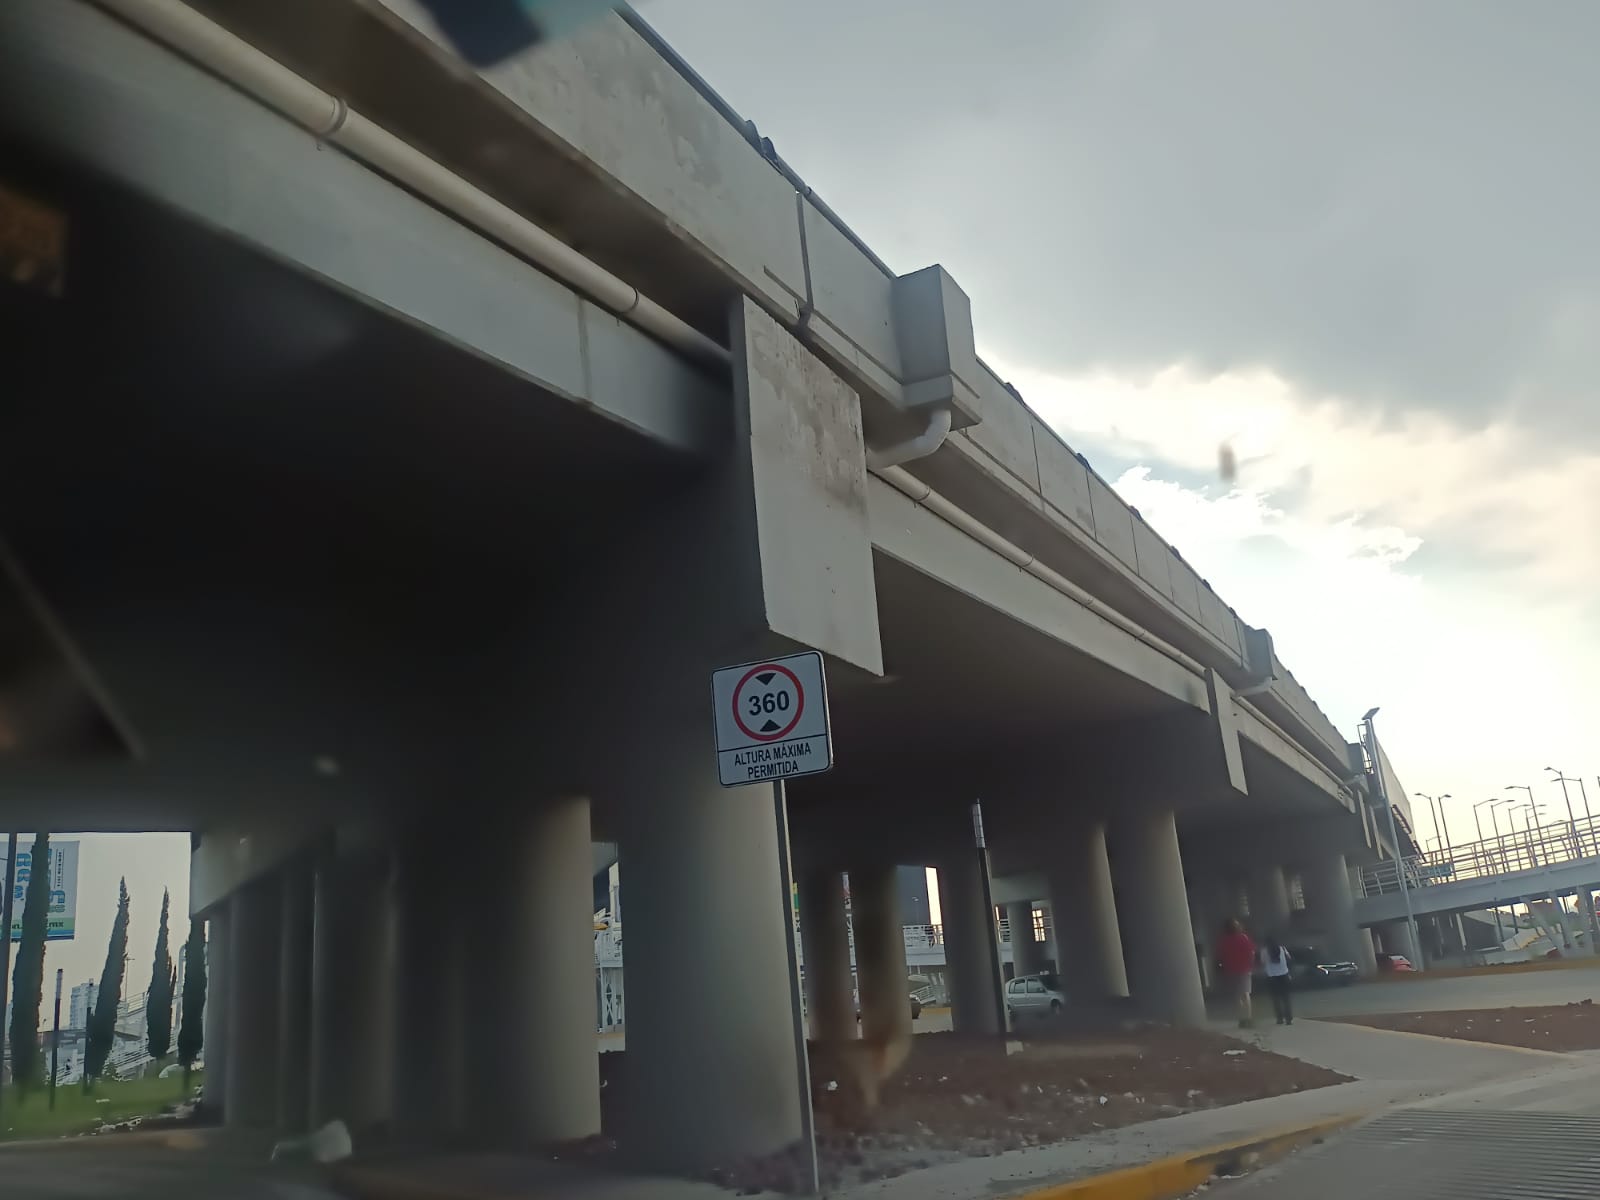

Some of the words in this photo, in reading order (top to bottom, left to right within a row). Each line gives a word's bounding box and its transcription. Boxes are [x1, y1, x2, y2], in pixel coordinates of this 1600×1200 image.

[749, 690, 789, 715] 360
[735, 749, 771, 765] ALTURA
[773, 743, 811, 759] MÁXIMA
[748, 761, 798, 778] PERMITIDA
